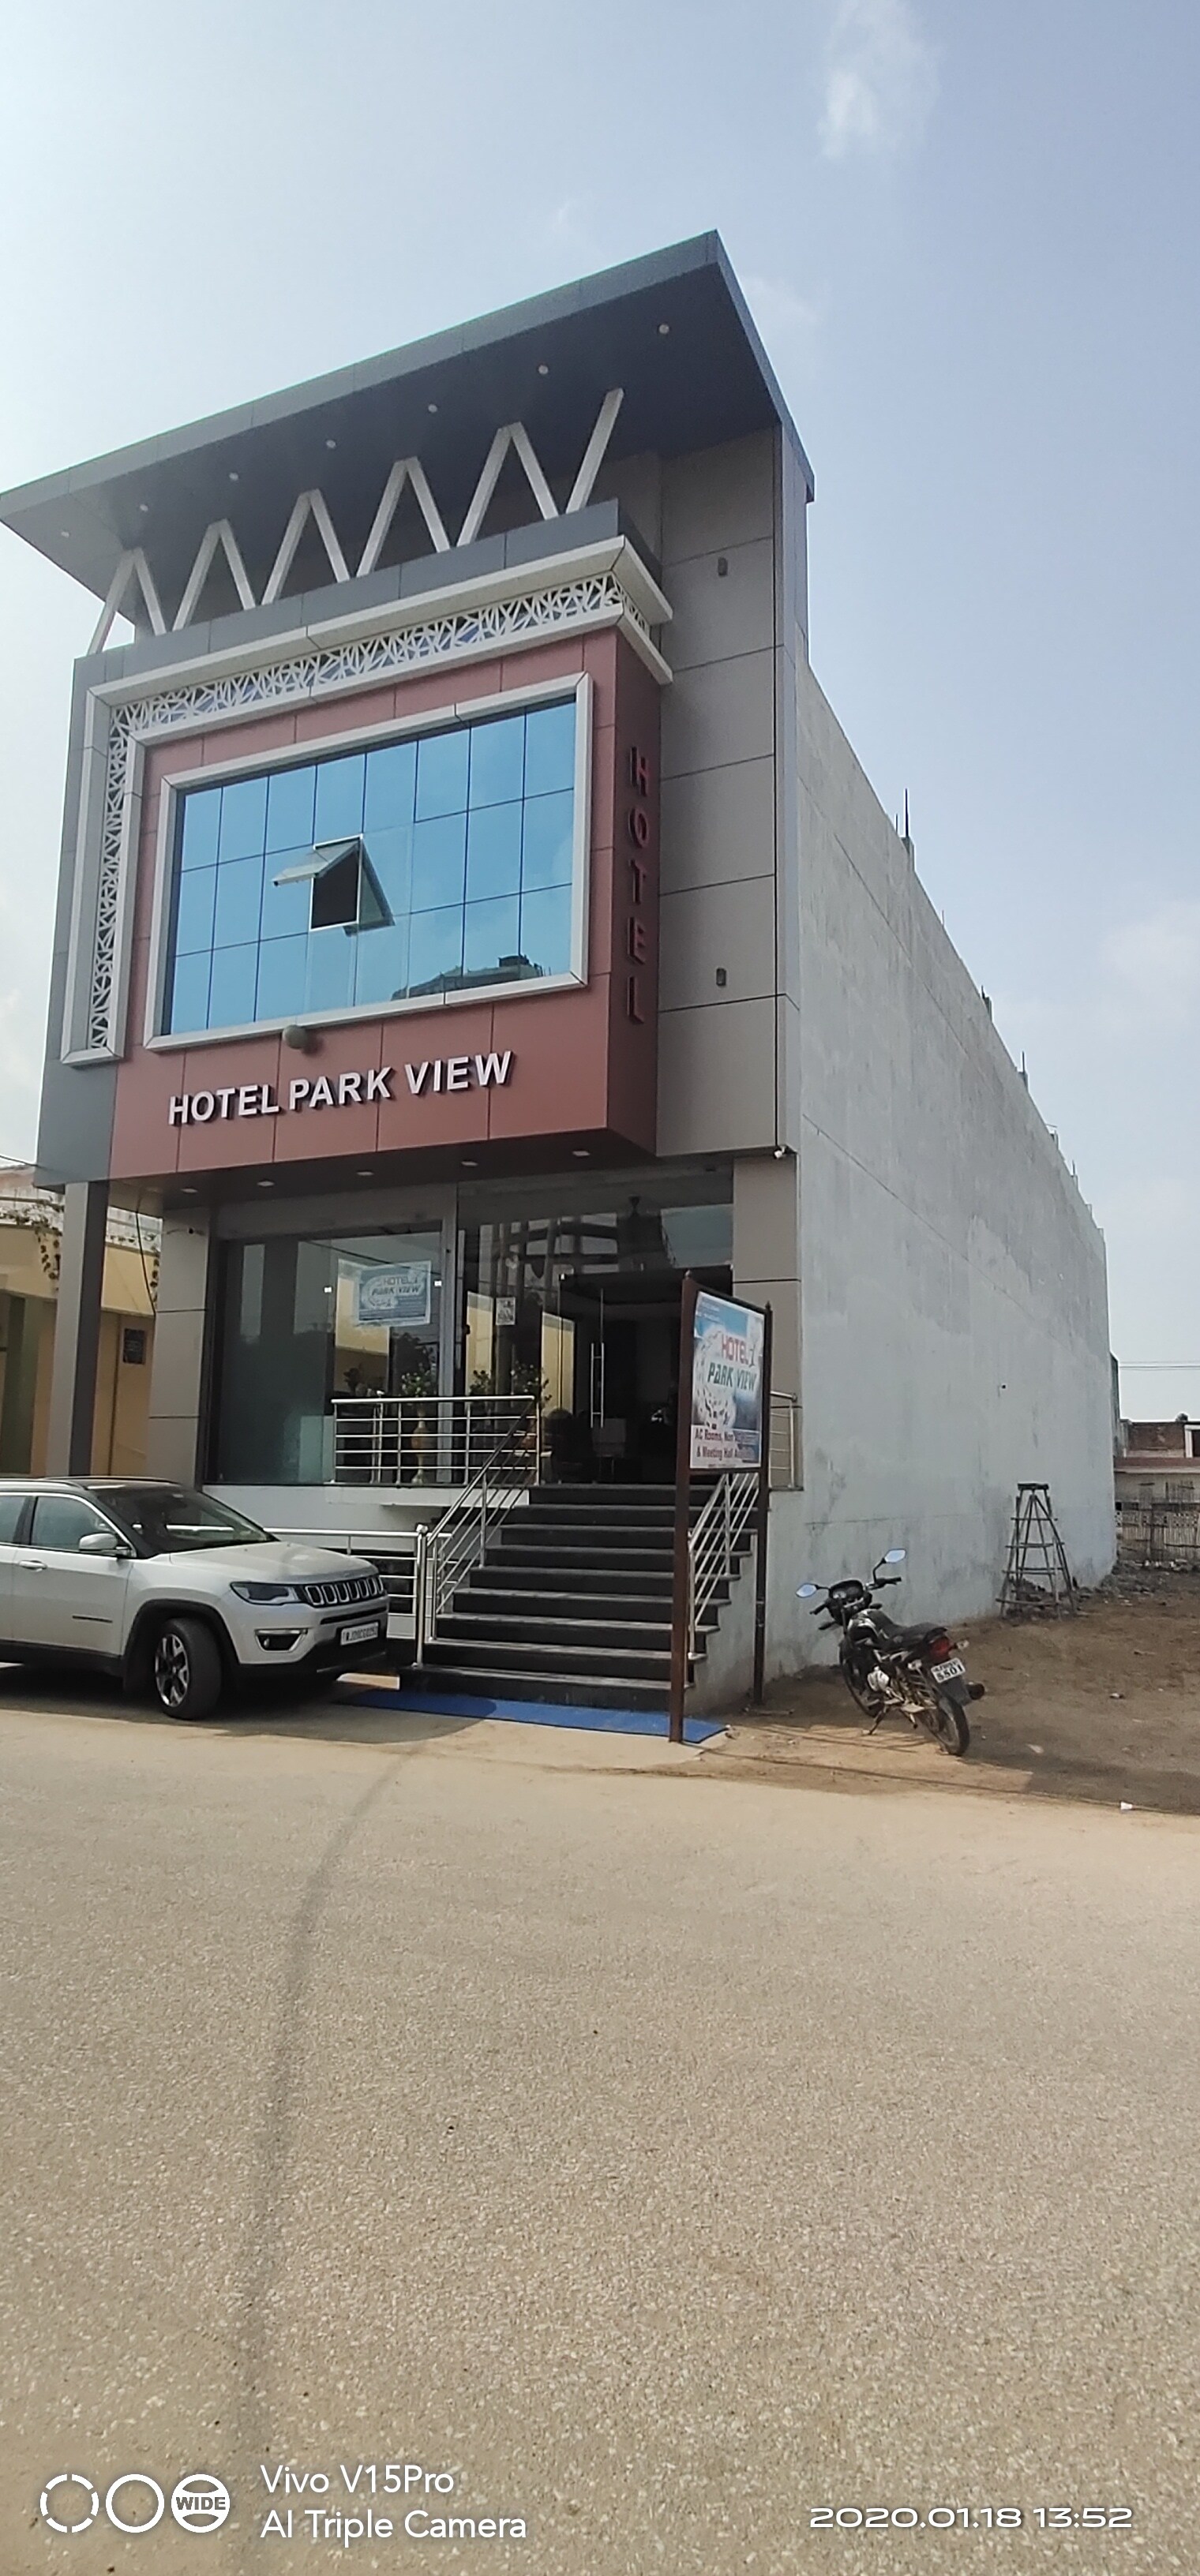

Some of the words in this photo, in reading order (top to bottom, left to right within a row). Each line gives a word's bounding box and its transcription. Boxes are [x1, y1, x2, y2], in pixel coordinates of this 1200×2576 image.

[627, 746, 650, 1024] HOTEL
[168, 1084, 280, 1125] HOTEL
[288, 1066, 392, 1110] PARK
[404, 1050, 512, 1095] VIEW
[383, 1275, 412, 1285] HOTEL
[722, 1334, 748, 1365] HOTEL
[737, 1368, 757, 1391] VIEW
[695, 1428, 703, 1440] AC
